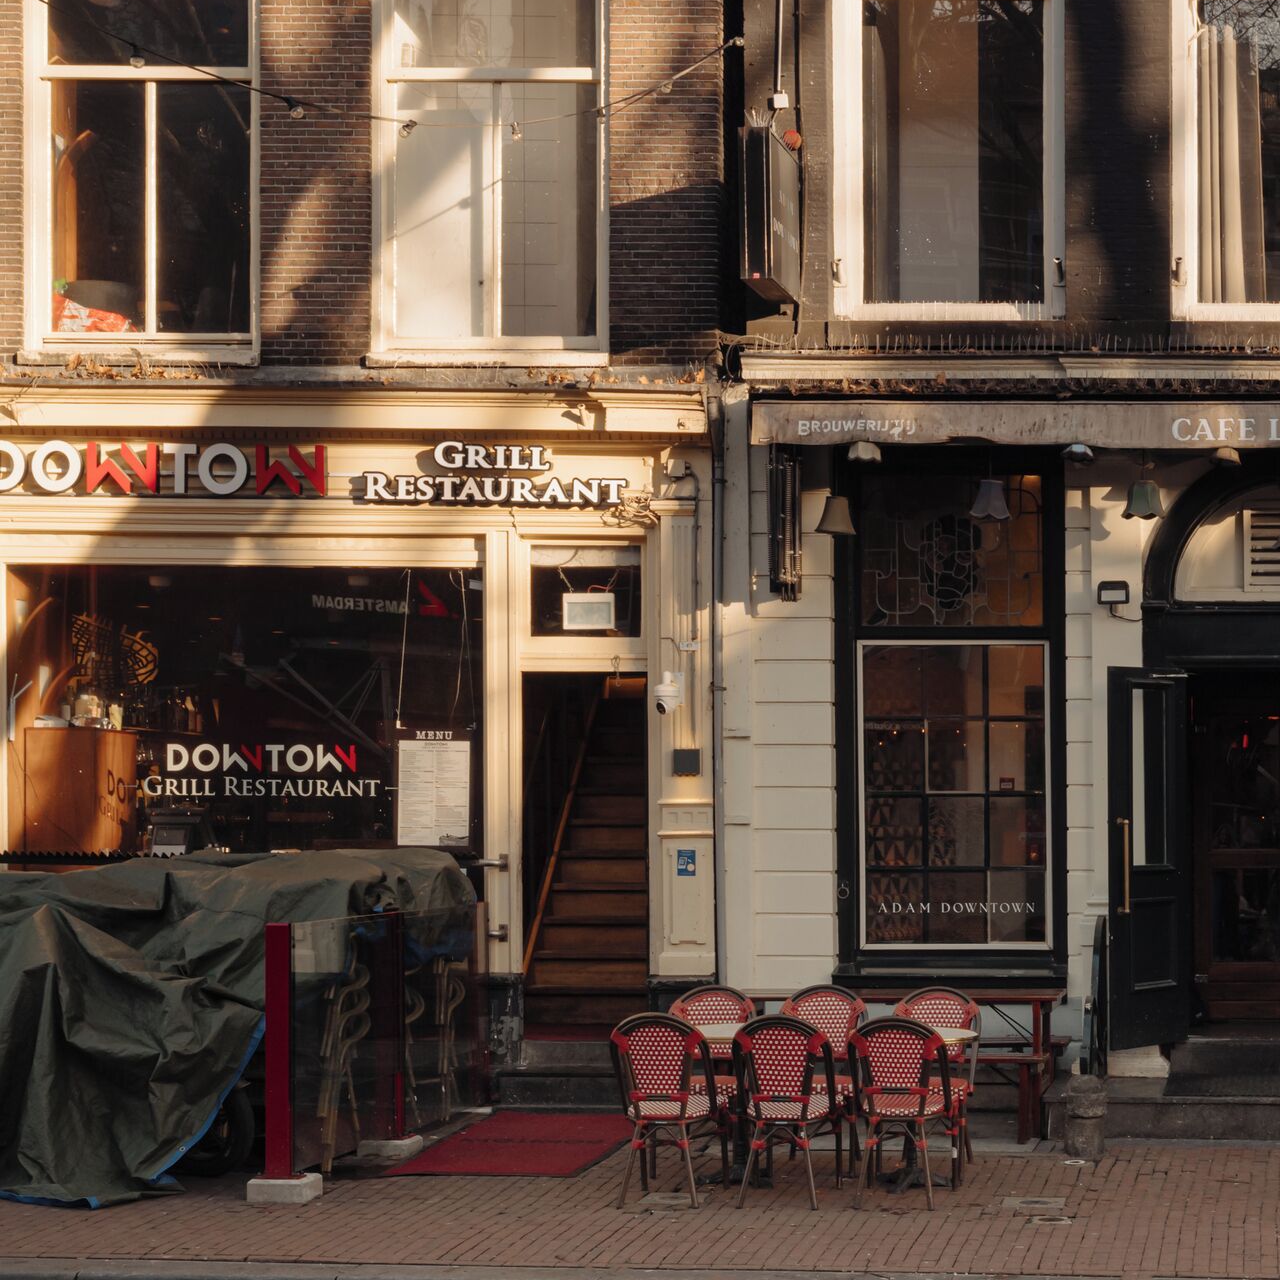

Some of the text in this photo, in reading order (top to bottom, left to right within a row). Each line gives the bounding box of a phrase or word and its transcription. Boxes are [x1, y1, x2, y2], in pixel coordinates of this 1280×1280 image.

[798, 420, 889, 436] BROUWERIJ
[1171, 418, 1256, 441] CAFE
[433, 441, 550, 470] GRILL
[363, 472, 627, 504] RESTAURANT
[415, 730, 453, 740] MENU
[167, 743, 357, 773] DOWNTOWN
[143, 775, 380, 797] GRILL RESTAURANT
[878, 902, 1037, 914] ADAM DOWNTOWN
